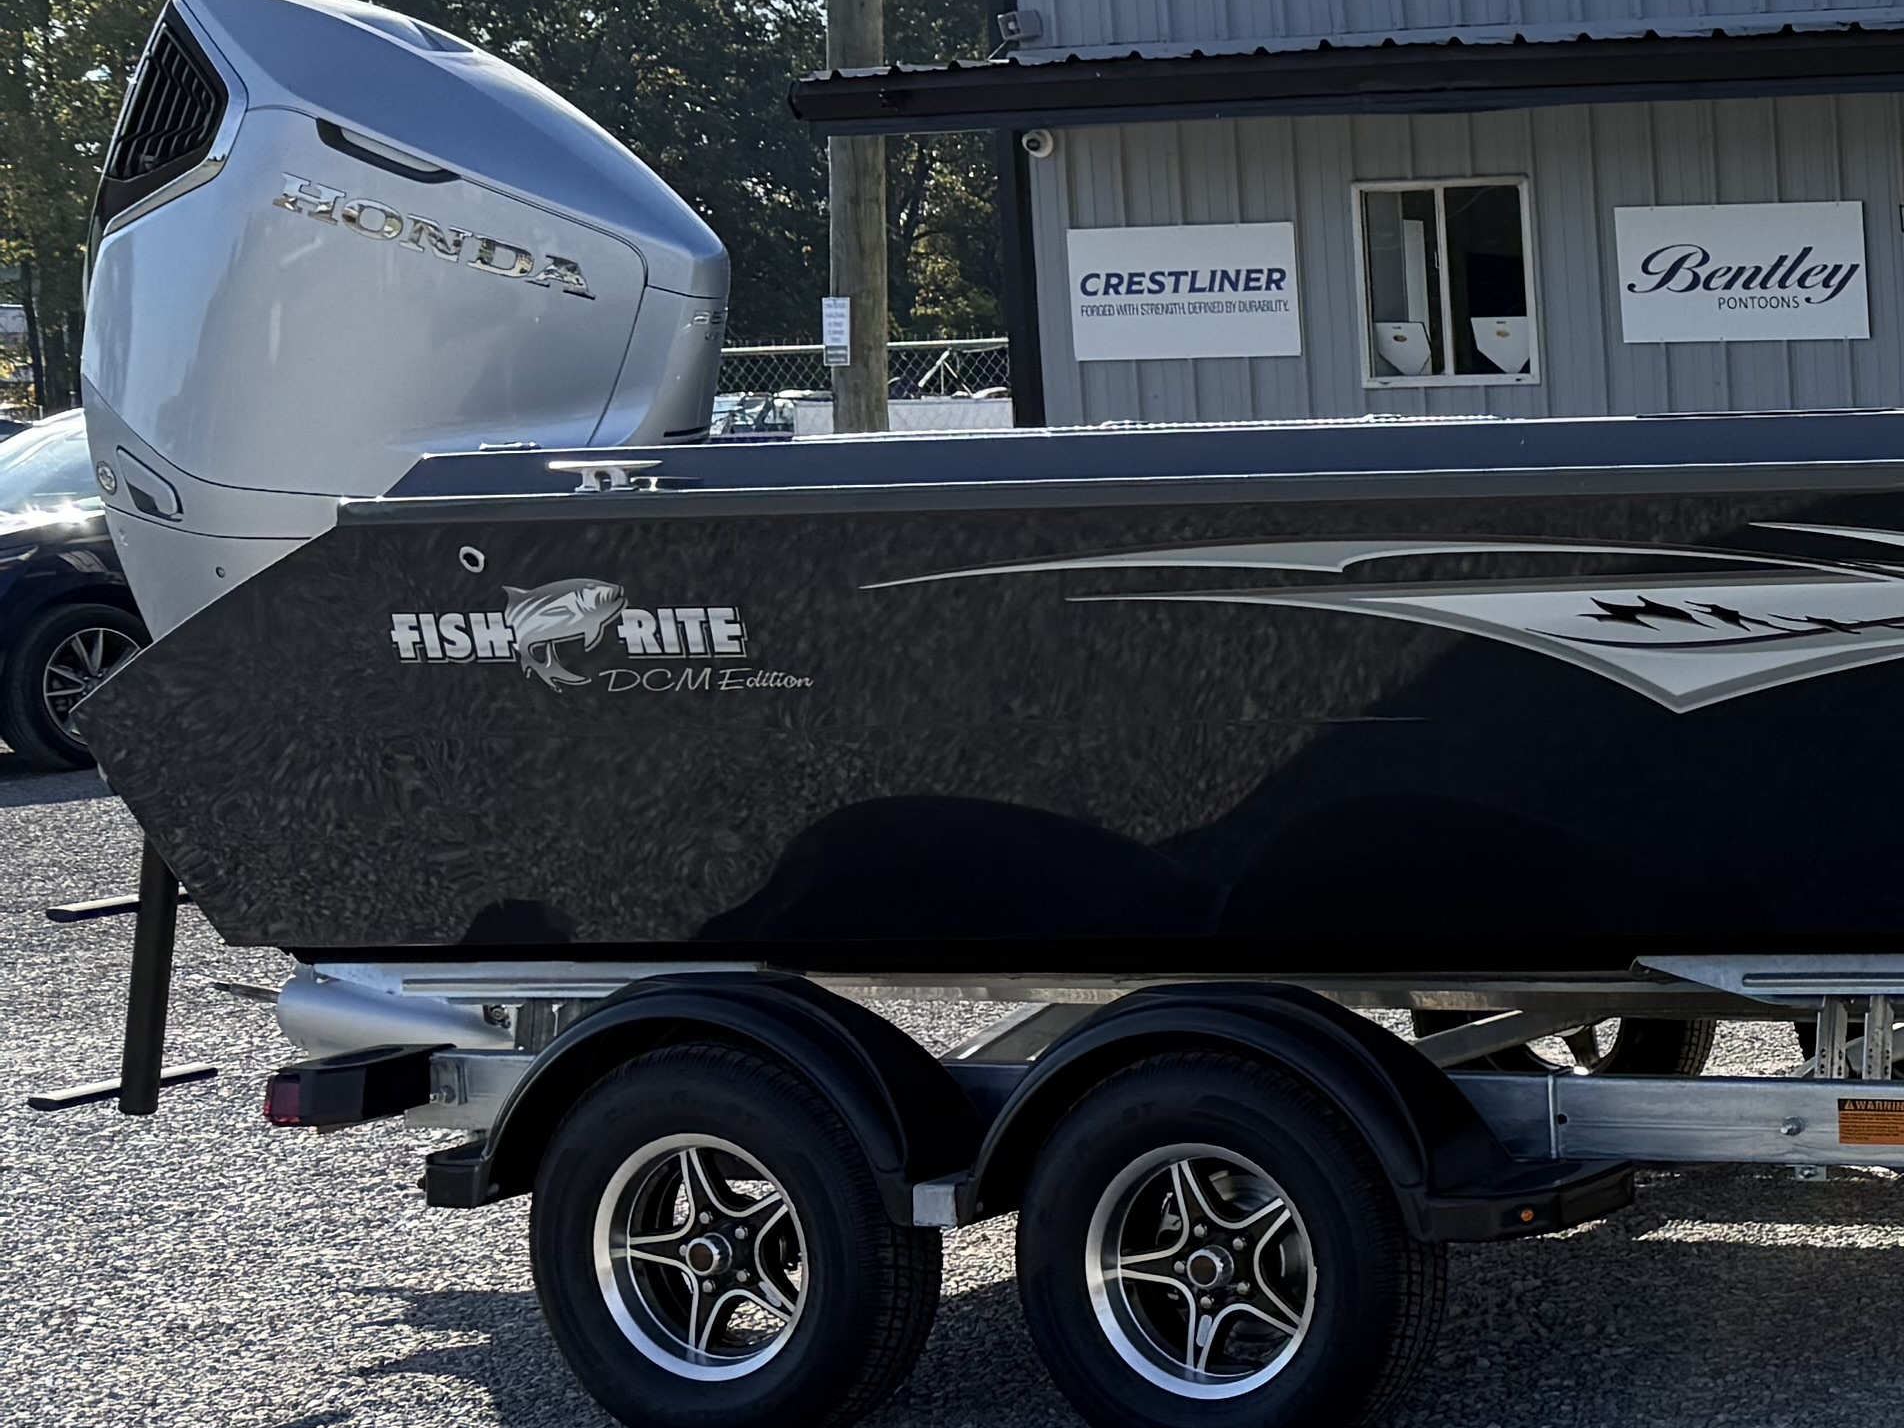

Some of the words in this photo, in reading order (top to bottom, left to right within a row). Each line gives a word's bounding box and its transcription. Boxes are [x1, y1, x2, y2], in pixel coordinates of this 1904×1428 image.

[272, 171, 597, 301] HONDA
[1080, 268, 1287, 297] CRESTLINER
[1627, 244, 1860, 304] Bentley
[1081, 304, 1116, 317] FORGED
[1116, 303, 1139, 316] WITH
[1187, 300, 1224, 315] DEFINED
[1225, 300, 1237, 313] BY
[1718, 295, 1800, 310] PONTOONS
[391, 612, 520, 663] FISH
[617, 606, 748, 659] RITE
[599, 668, 711, 693] DCM
[717, 667, 815, 692] Edition
